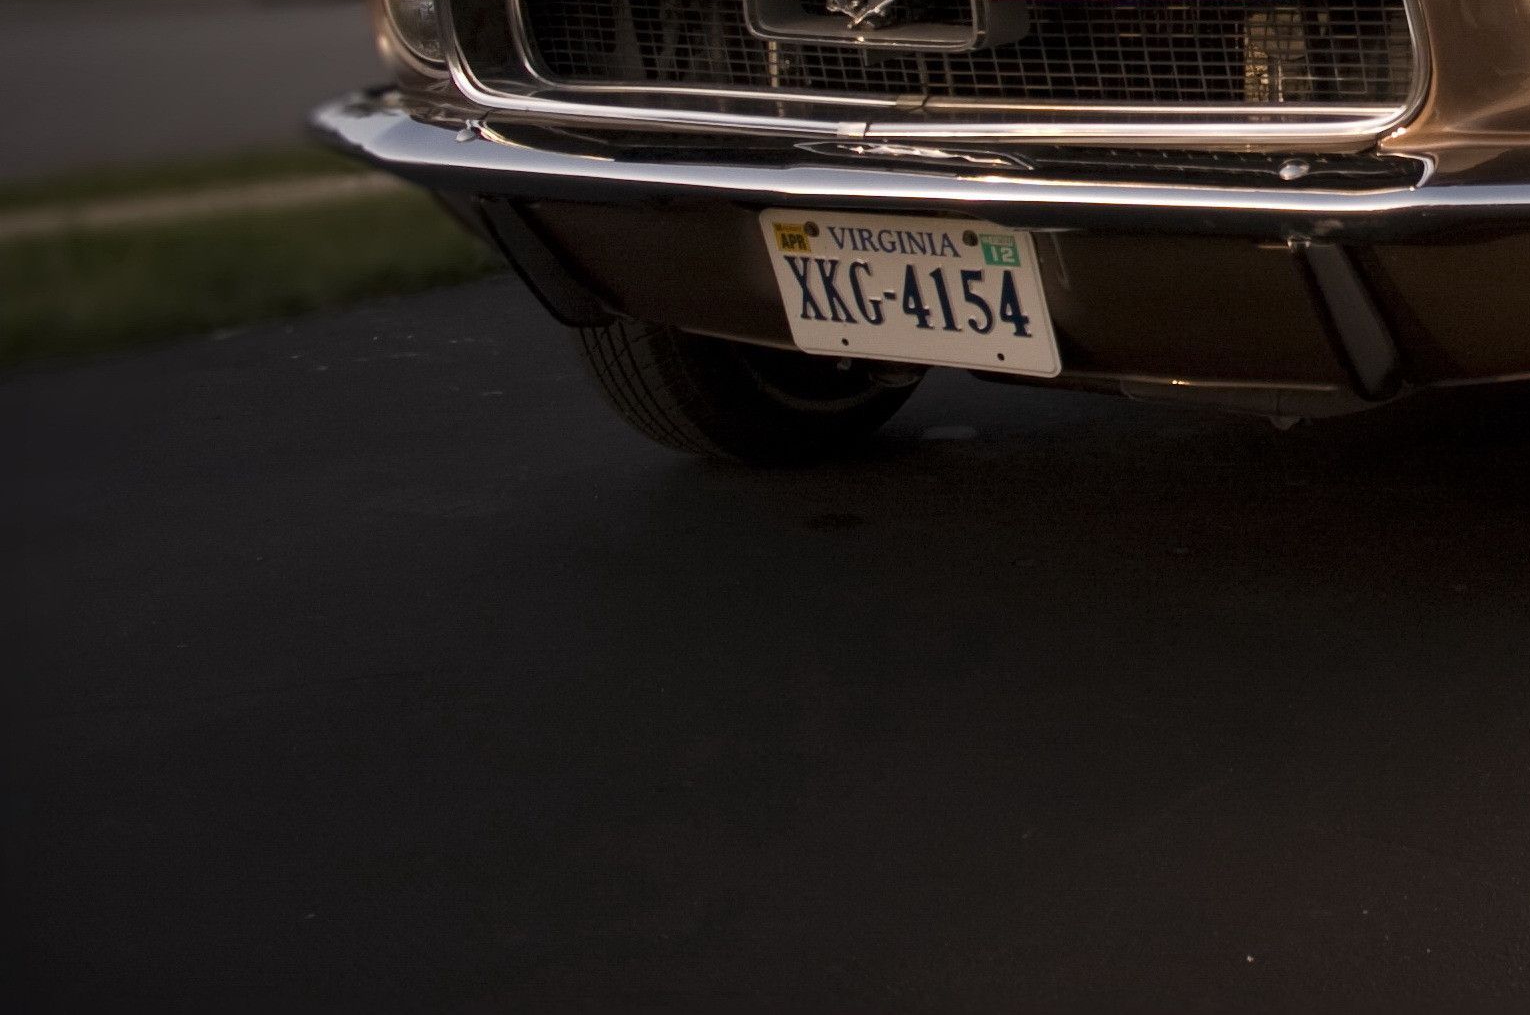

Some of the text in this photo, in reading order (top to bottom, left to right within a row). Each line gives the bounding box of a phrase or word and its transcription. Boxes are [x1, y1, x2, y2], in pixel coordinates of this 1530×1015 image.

[827, 226, 962, 258] VIRGINIA
[990, 245, 1016, 263] 12
[784, 255, 1033, 338] XKG-4154
